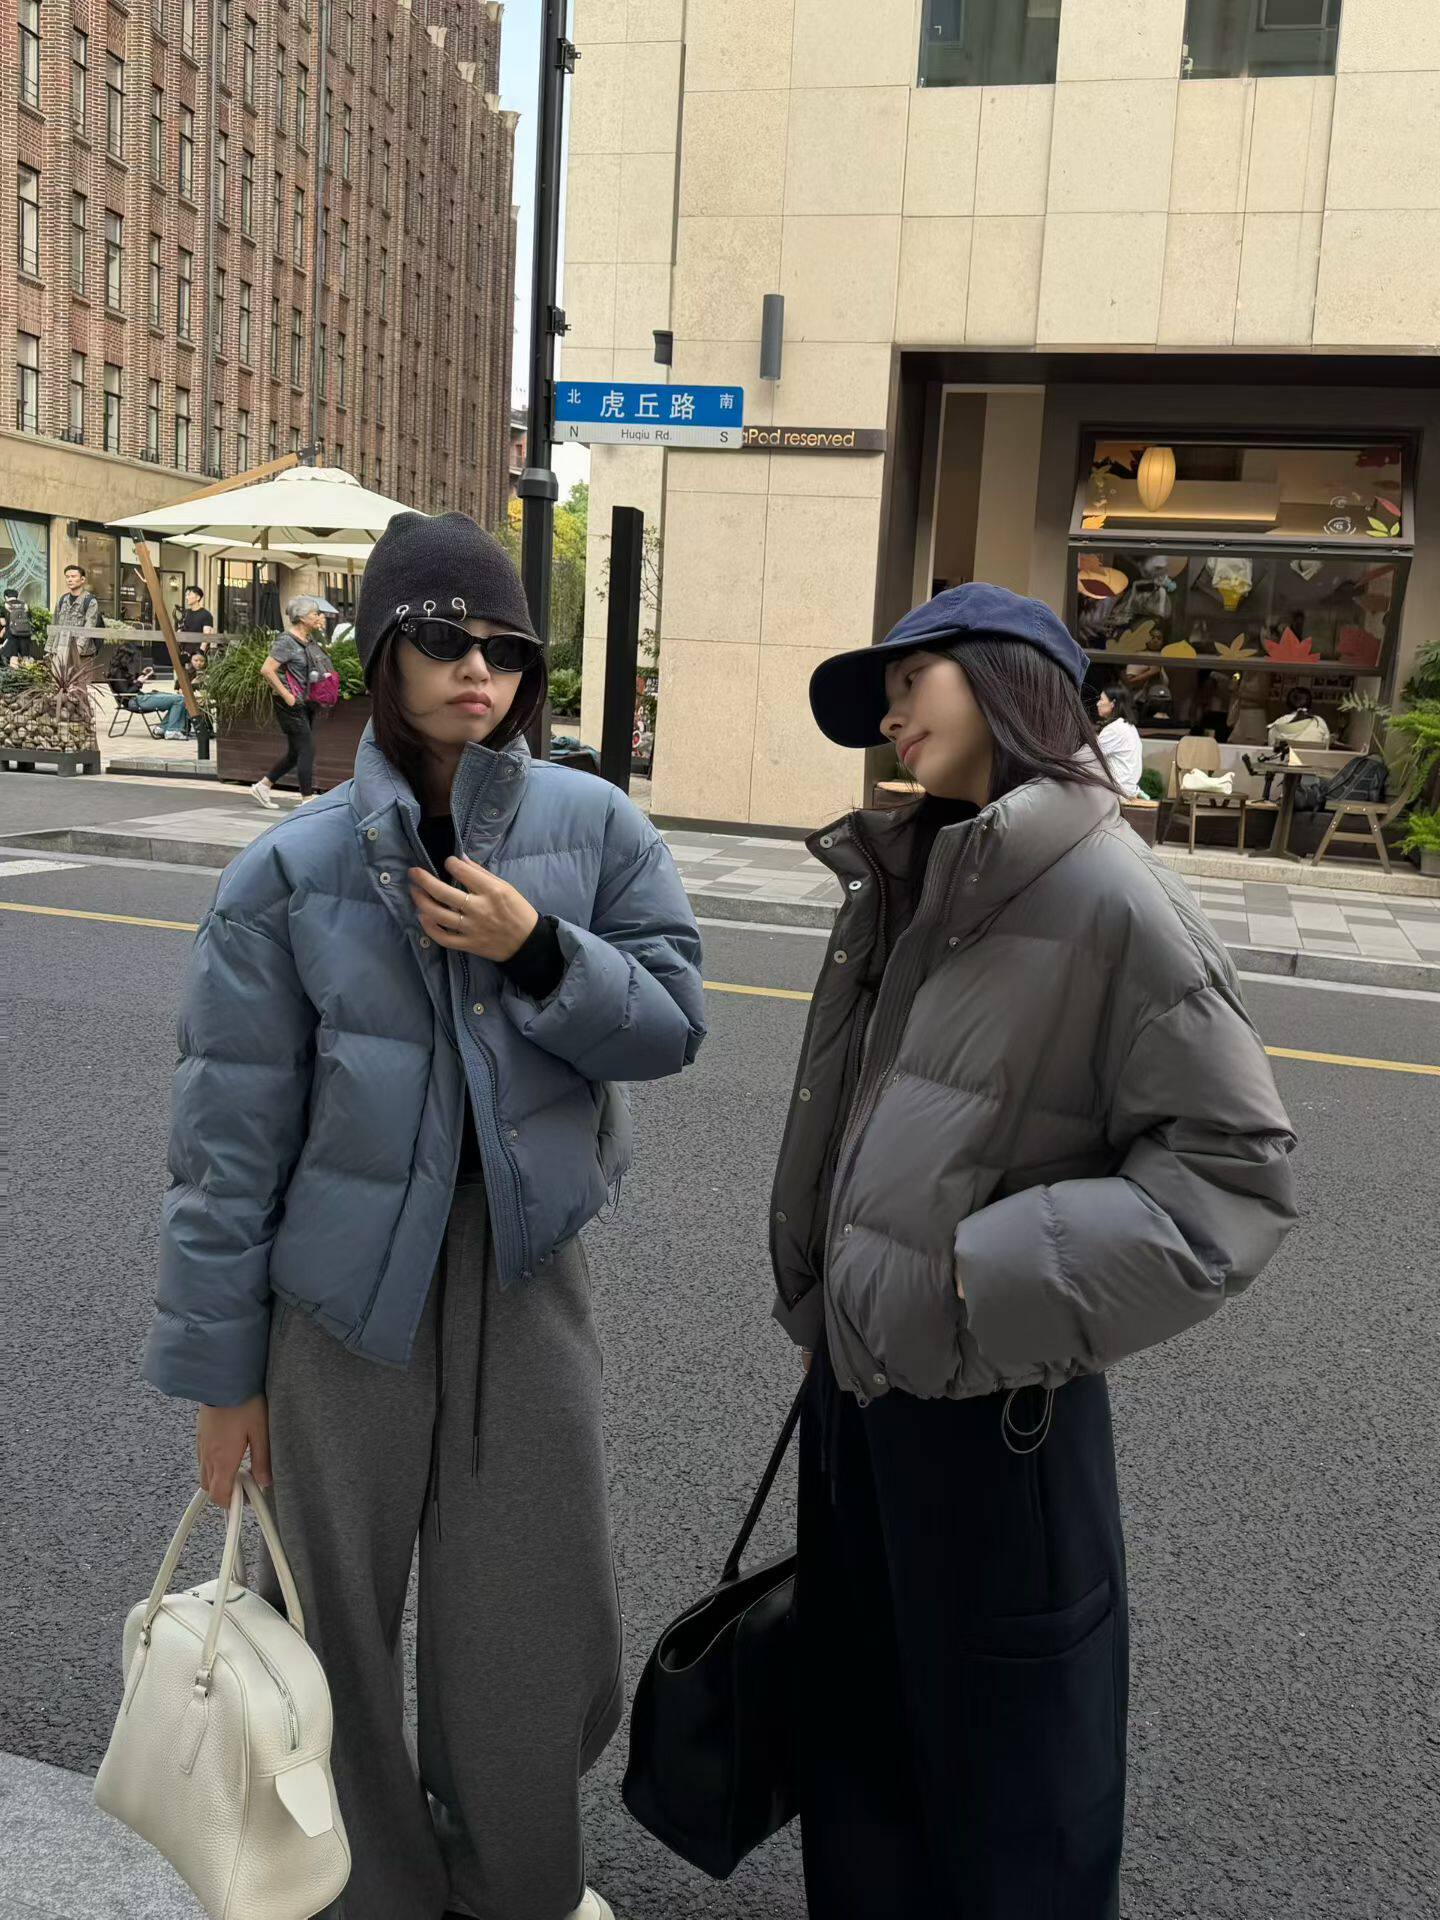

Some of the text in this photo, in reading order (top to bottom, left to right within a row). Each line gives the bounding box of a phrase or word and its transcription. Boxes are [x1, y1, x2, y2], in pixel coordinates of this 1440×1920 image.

[567, 388, 734, 420] 北 虎丘路 南
[569, 425, 729, 443] N Huqiu Rd. S
[784, 431, 855, 447] reserved
